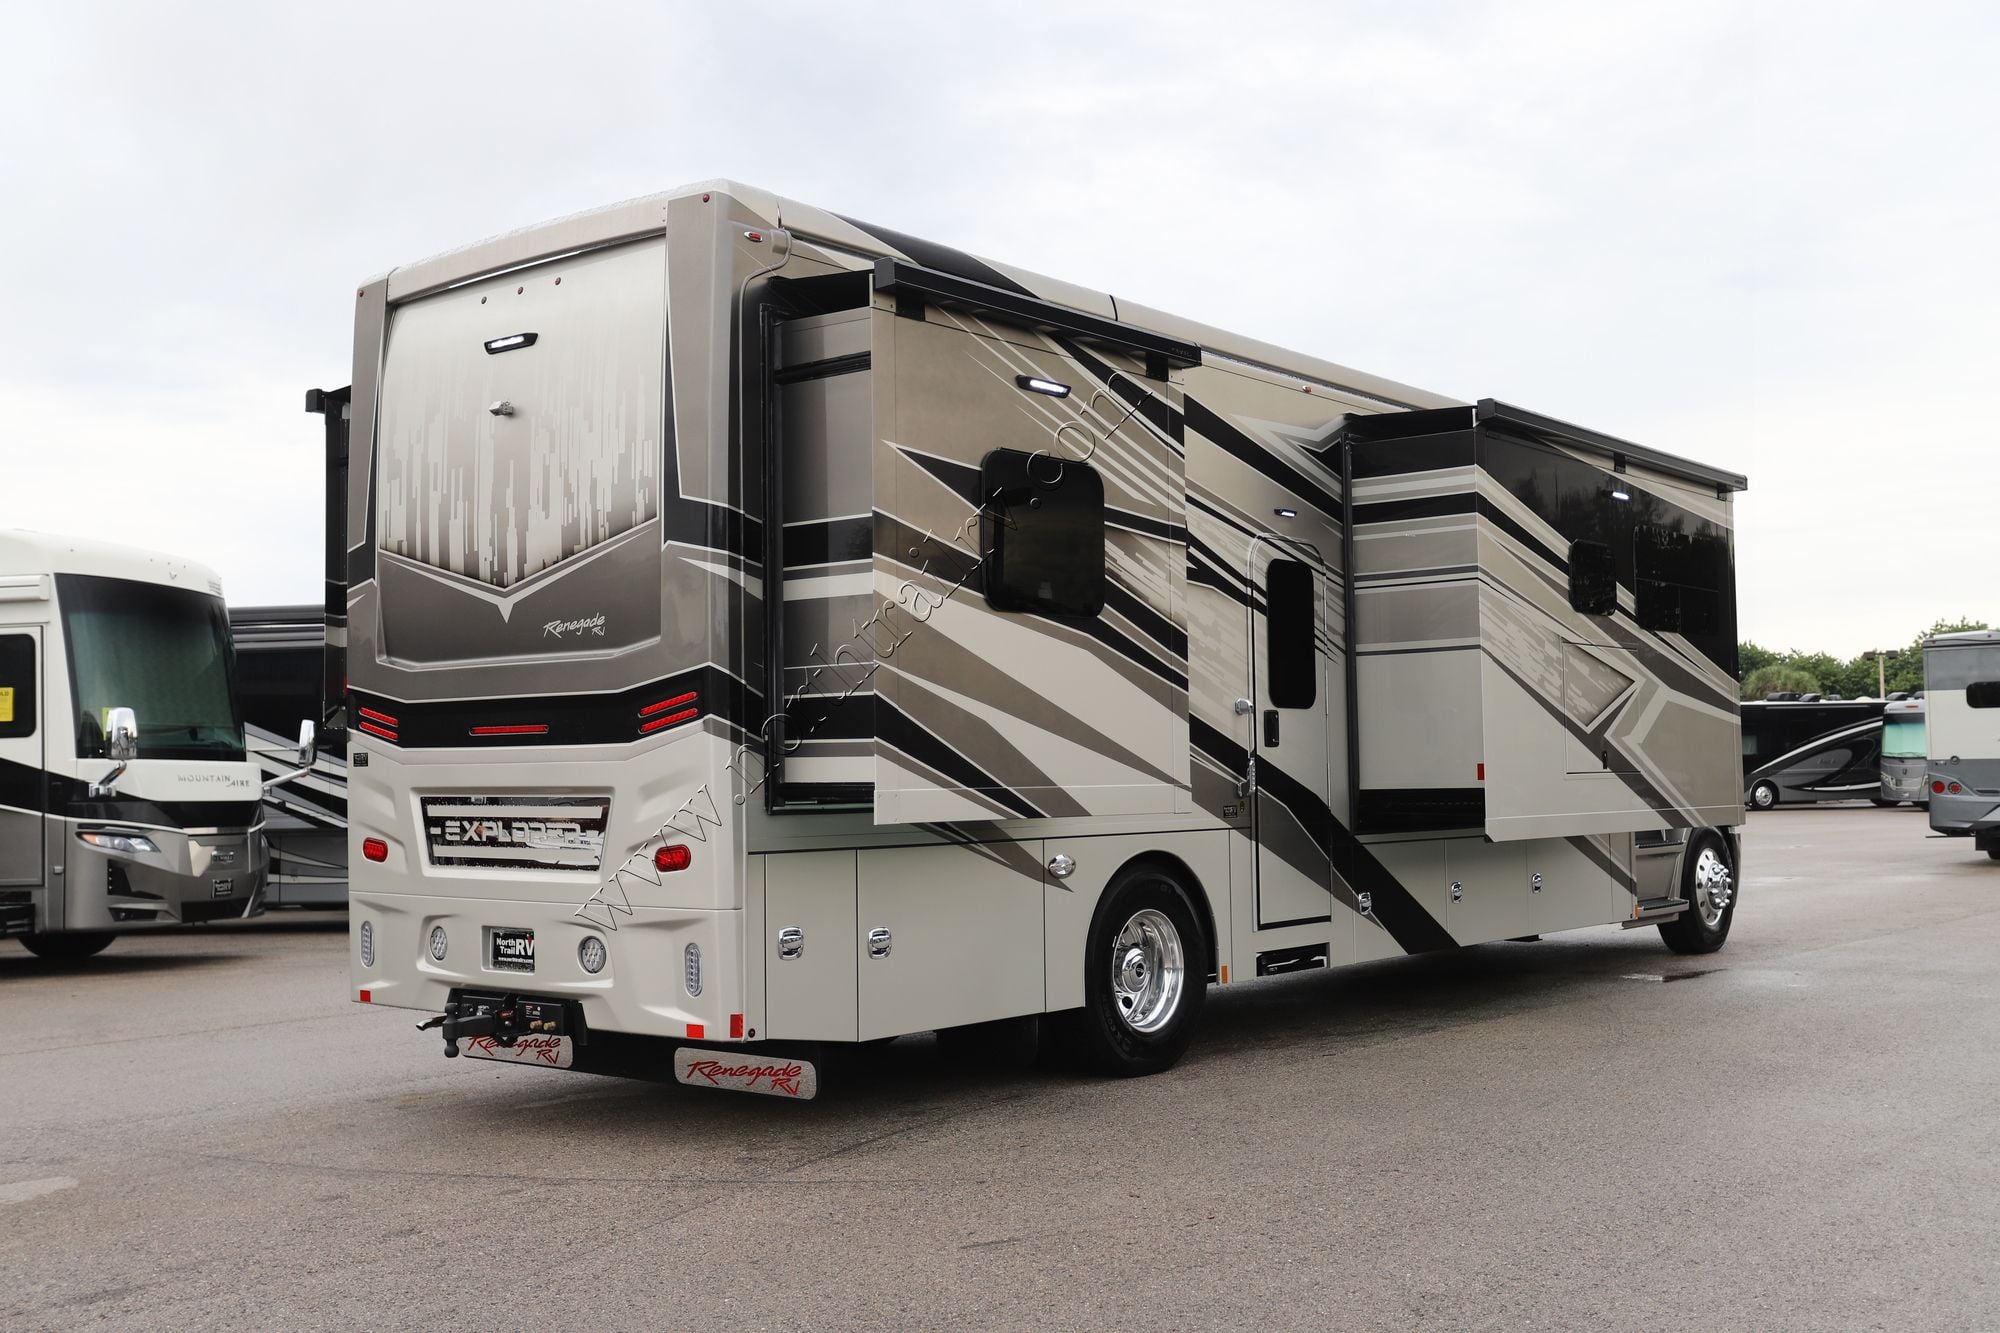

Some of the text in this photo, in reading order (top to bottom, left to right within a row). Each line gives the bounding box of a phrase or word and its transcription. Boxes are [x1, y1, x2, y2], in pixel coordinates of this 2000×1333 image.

[543, 612, 605, 638] Renegade
[591, 626, 605, 635] RV
[178, 774, 250, 787] MOUNTAIN AIRE
[496, 937, 515, 946] North
[515, 939, 534, 955] RV
[500, 946, 515, 954] Trail
[468, 1034, 561, 1056] Regade
[535, 1049, 560, 1064] RV
[686, 1061, 802, 1085] Renegade
[771, 1078, 801, 1095] RV
